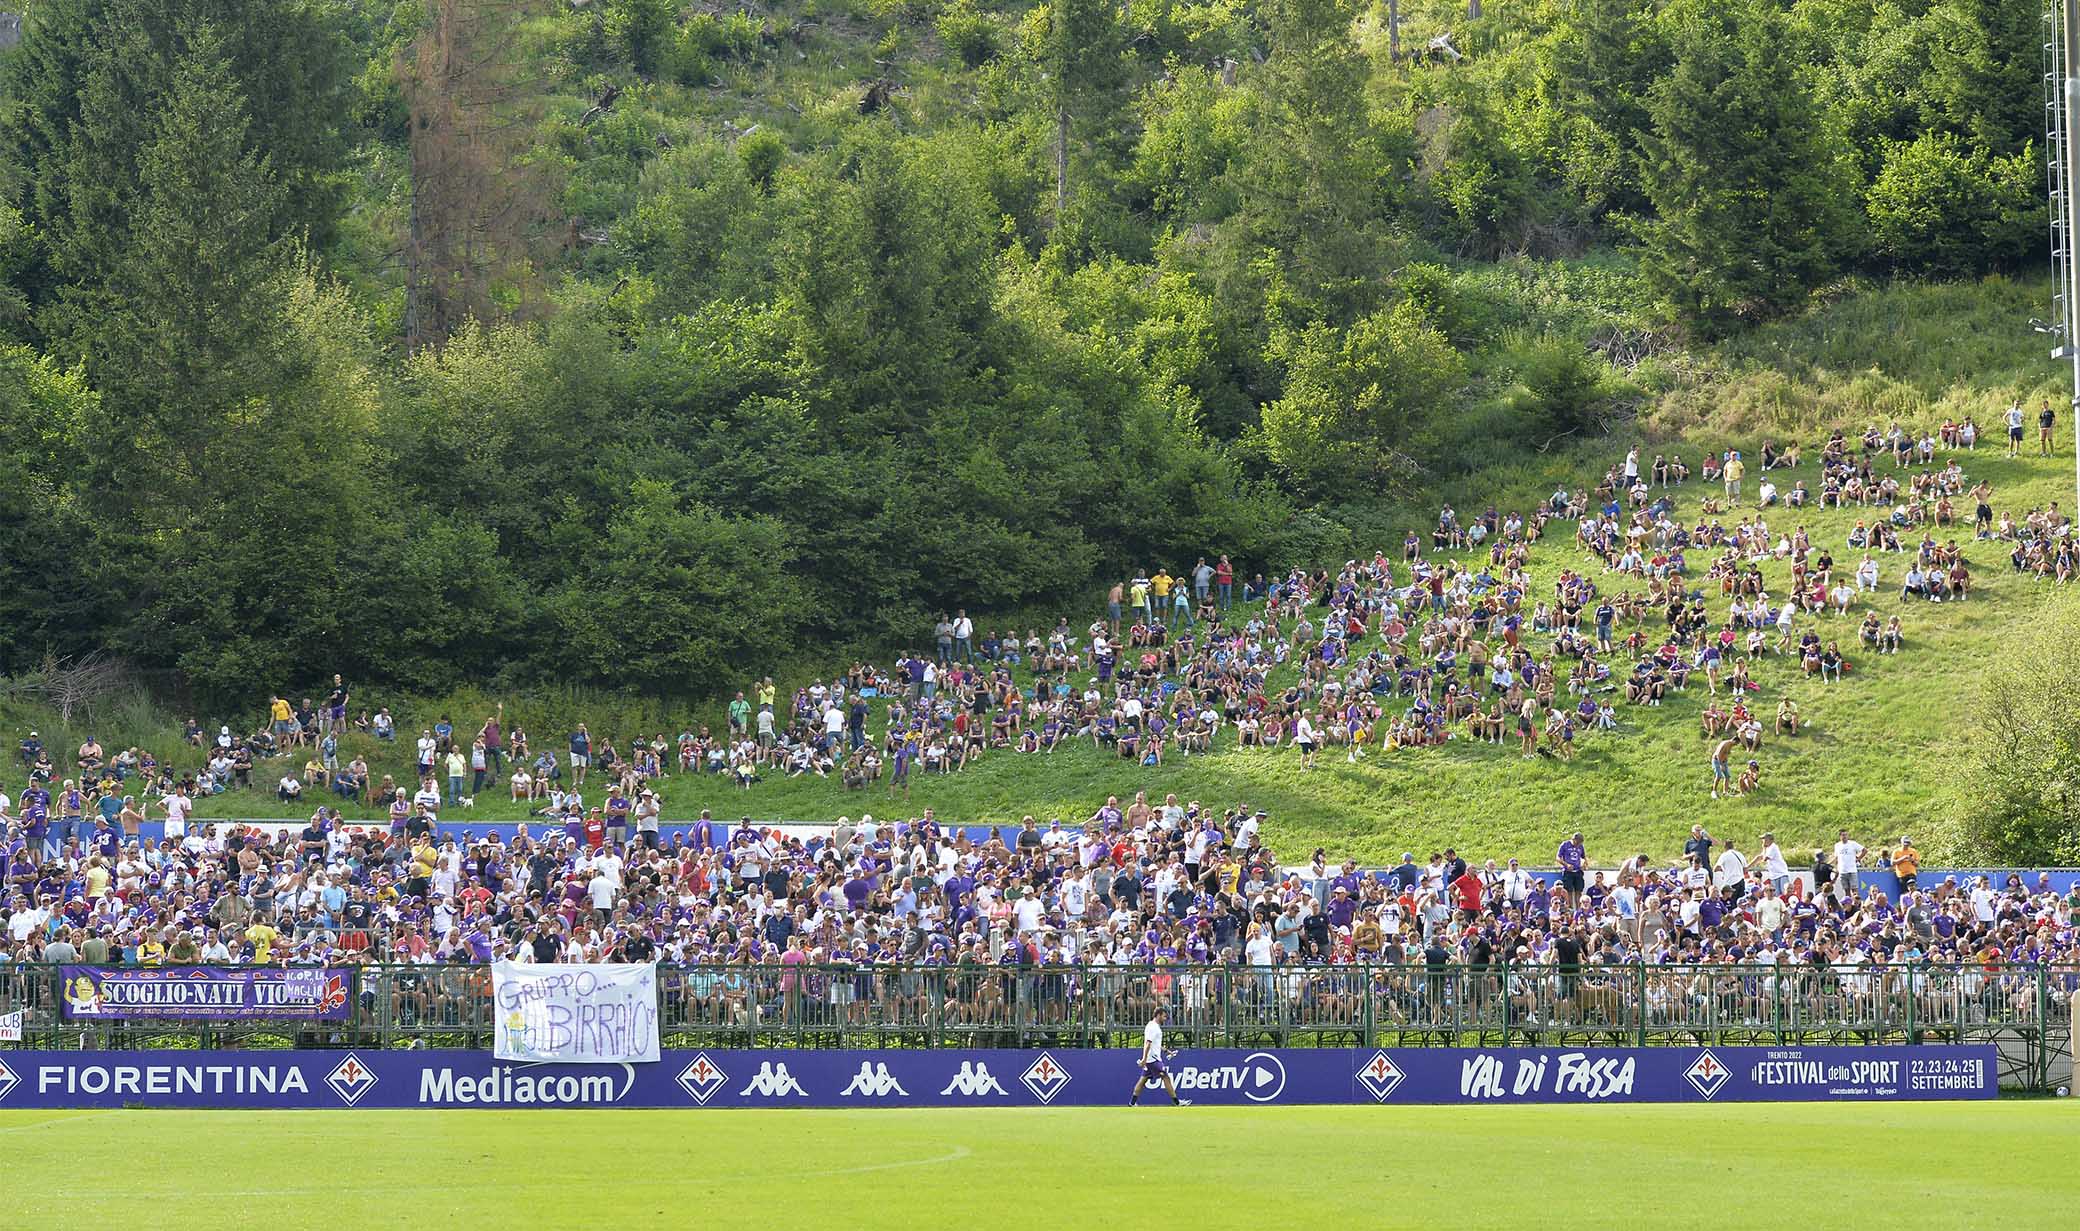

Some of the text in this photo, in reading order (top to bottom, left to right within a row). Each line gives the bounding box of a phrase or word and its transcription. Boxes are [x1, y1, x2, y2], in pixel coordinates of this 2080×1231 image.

[100, 970, 208, 979] VIOLA
[102, 983, 315, 1004] SCOGLIO-NATI VIO
[0, 1013, 20, 1029] UB
[1768, 1051, 1801, 1059] TRENTO 2022
[1461, 1054, 1505, 1098] VAL
[1555, 1052, 1635, 1098] FASSA
[1758, 1061, 1827, 1085] FESTIVAL
[1828, 1065, 1850, 1081] dello
[1851, 1061, 1899, 1084] SPORT
[1911, 1059, 1975, 1073] 22 23 24 25
[39, 1066, 309, 1094] FIORENTINA
[419, 1066, 614, 1103] Mediacom
[1911, 1075, 1976, 1089] SETTEMBRE
